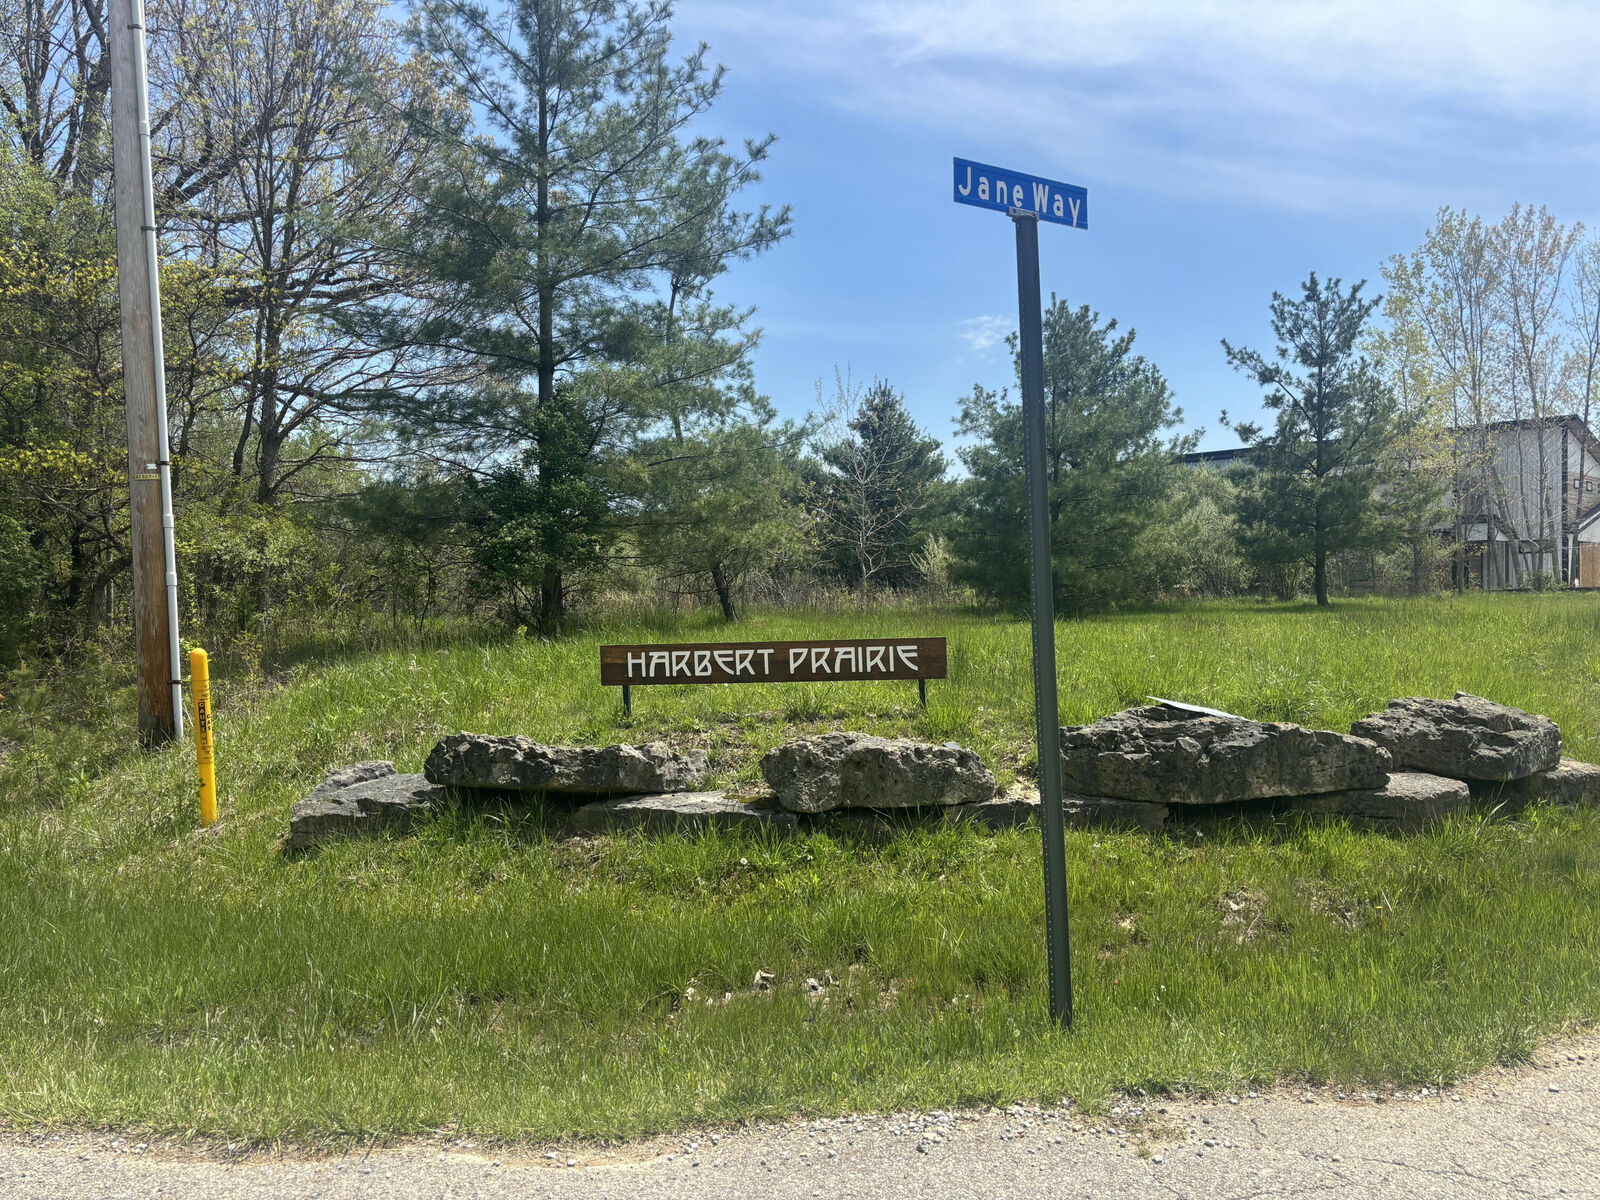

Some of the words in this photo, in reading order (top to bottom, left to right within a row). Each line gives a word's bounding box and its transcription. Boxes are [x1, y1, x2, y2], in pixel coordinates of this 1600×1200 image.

[958, 166, 1024, 208] Jane
[1032, 182, 1081, 227] Way
[627, 648, 775, 678] HARBERT
[789, 645, 919, 675] PRAIRIE
[199, 702, 207, 745] CAUTION
